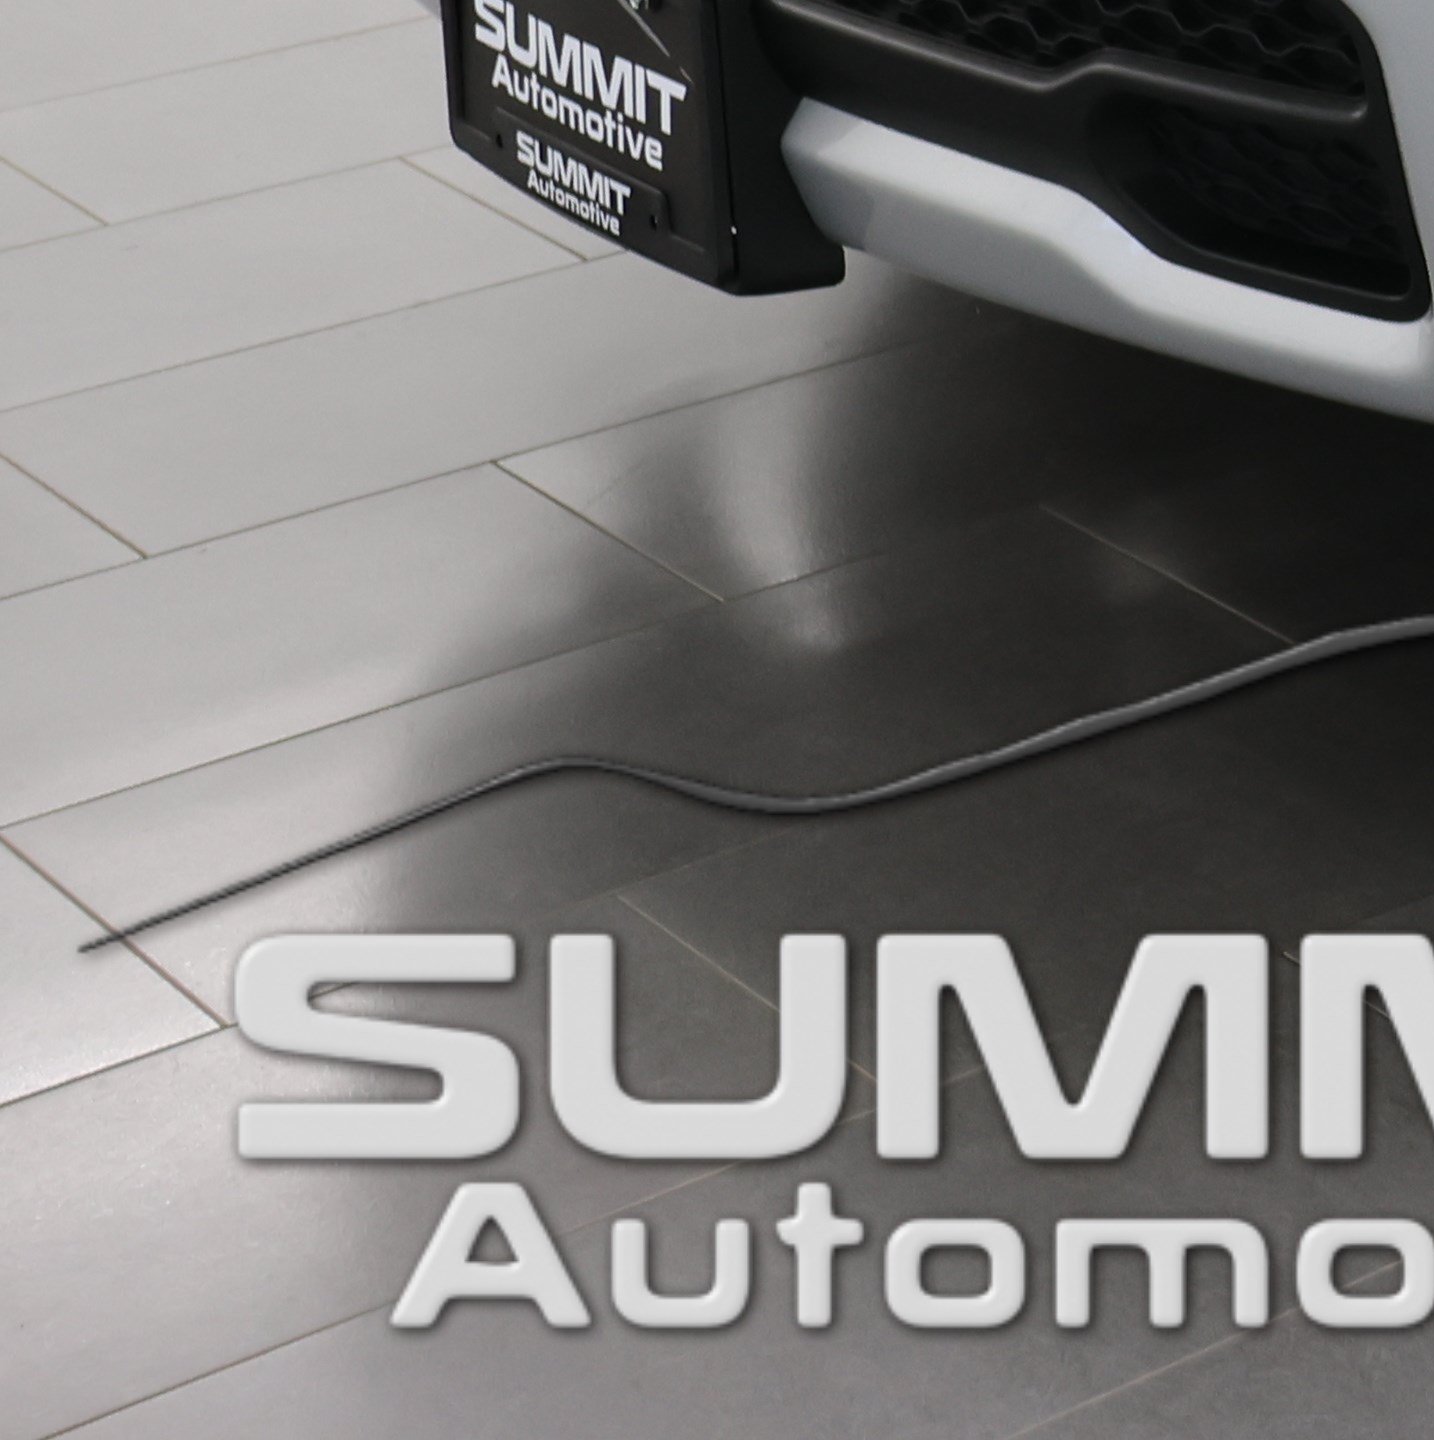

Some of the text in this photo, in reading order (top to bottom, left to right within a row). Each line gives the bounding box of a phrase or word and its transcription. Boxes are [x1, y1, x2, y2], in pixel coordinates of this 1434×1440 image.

[491, 54, 663, 171] Automotive
[516, 130, 631, 215] SUMMIT
[527, 169, 620, 236] Automotive
